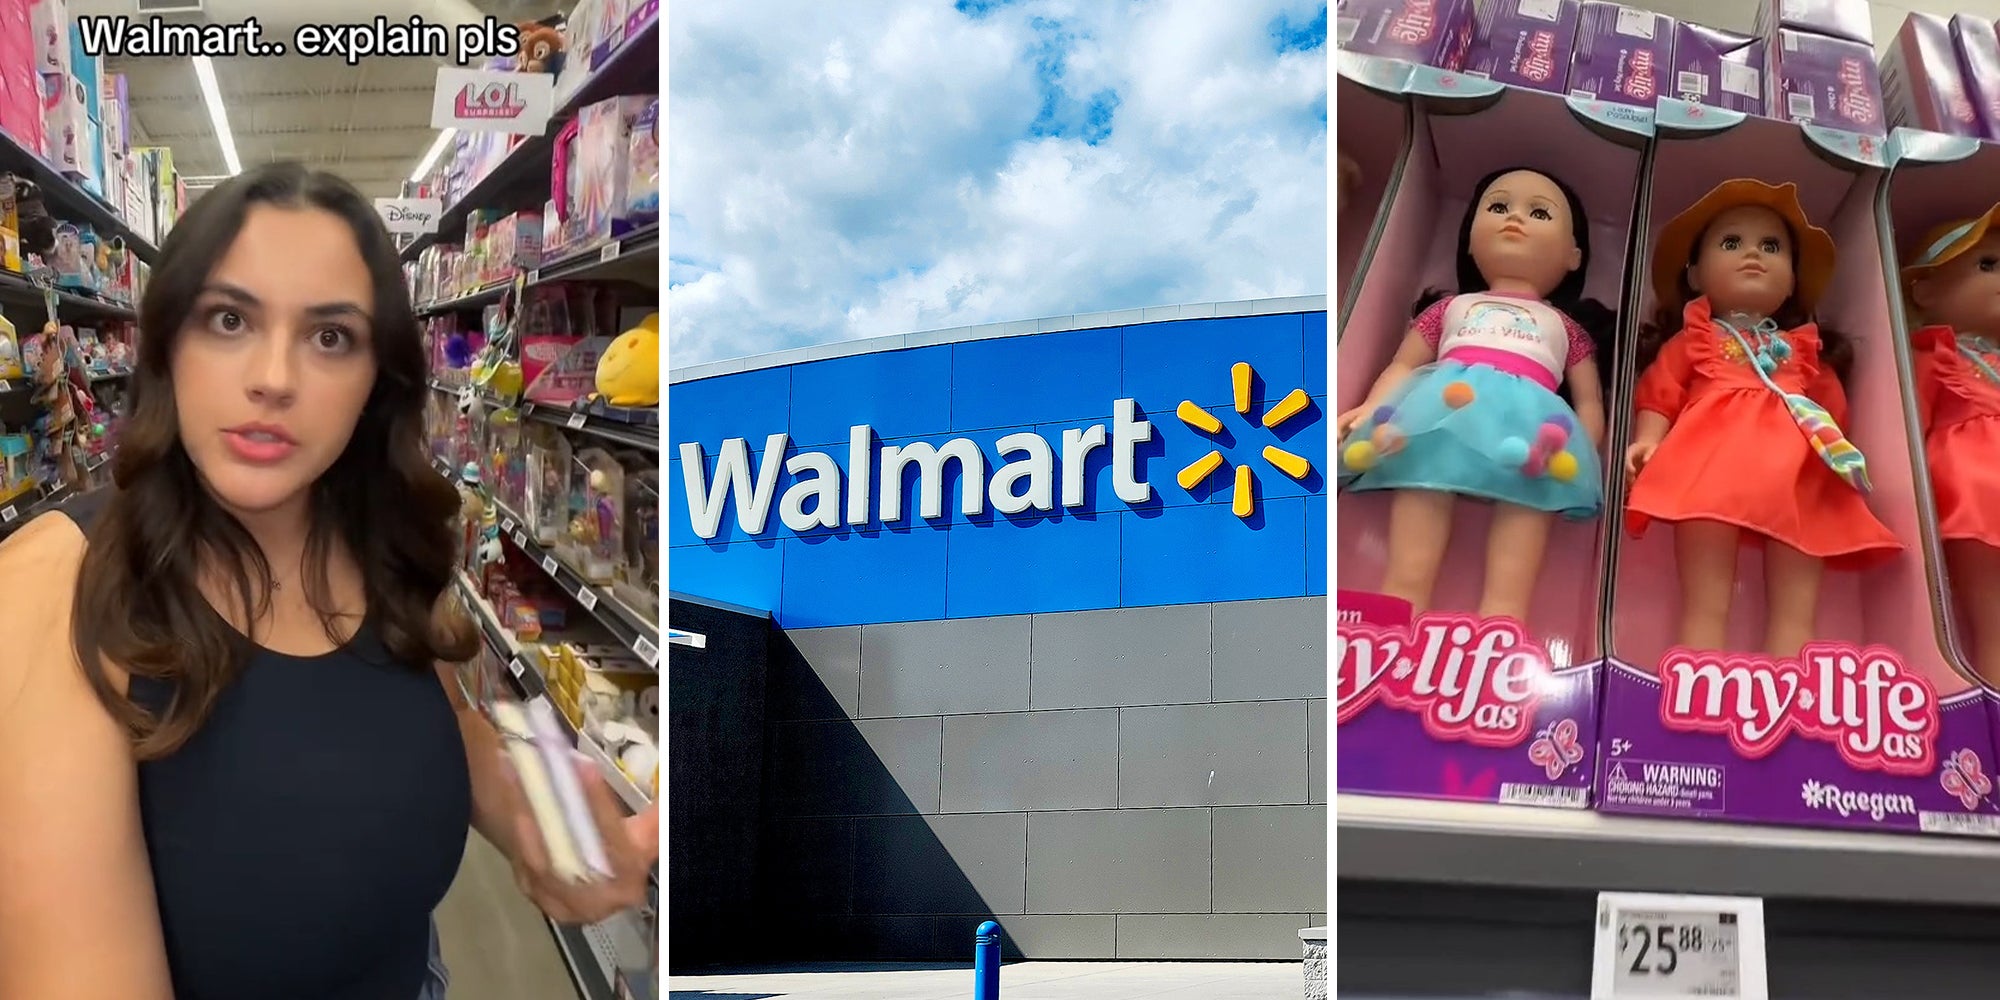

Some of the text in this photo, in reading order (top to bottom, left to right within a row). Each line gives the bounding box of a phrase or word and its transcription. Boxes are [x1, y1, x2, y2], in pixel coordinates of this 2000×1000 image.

[384, 204, 431, 226] Disney
[679, 397, 1151, 540] Walmart
[1413, 625, 1537, 722] life
[1475, 704, 1519, 730] as
[1672, 656, 1927, 752] my life
[1611, 738, 1632, 756] 5+
[1883, 732, 1922, 758] as
[1643, 763, 1722, 788] WARNING:
[1821, 784, 1916, 821] Raegan
